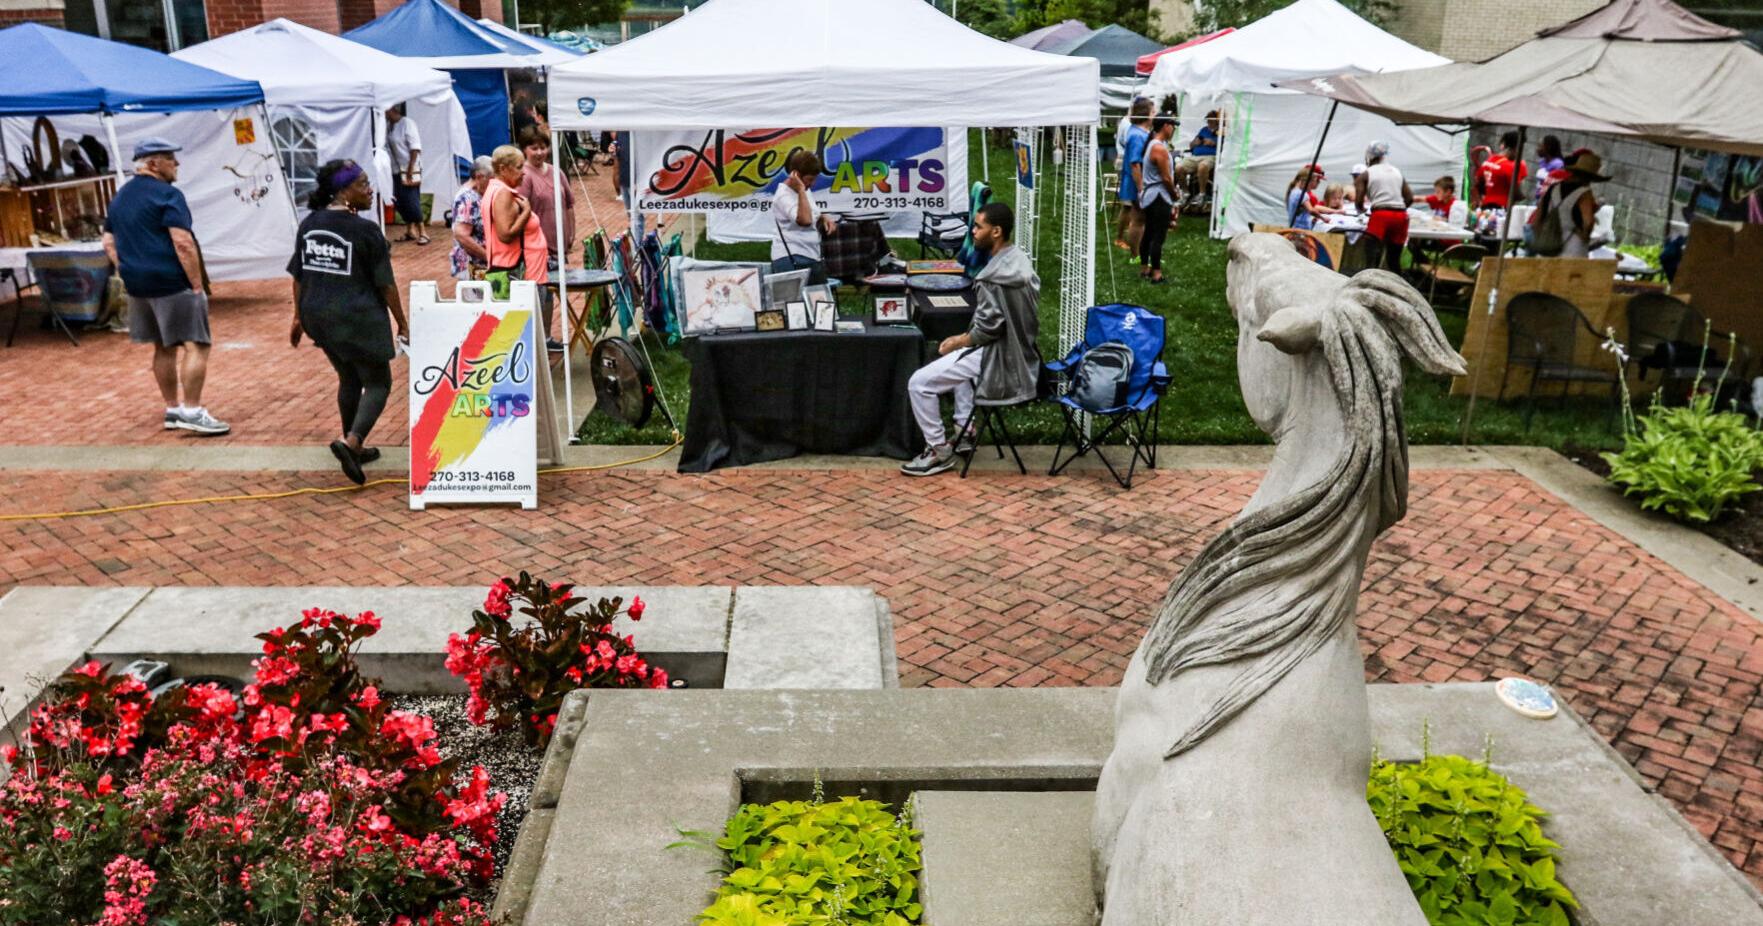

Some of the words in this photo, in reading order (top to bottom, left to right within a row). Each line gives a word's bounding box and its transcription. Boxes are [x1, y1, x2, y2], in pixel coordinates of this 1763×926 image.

[830, 159, 946, 193] ARTS
[639, 198, 828, 212] Leezadukesexpo@gm
[853, 197, 945, 209] 270-313-4168
[414, 342, 529, 395] Azeel
[452, 393, 530, 417] ARTS
[430, 471, 515, 482] 270-313-4168
